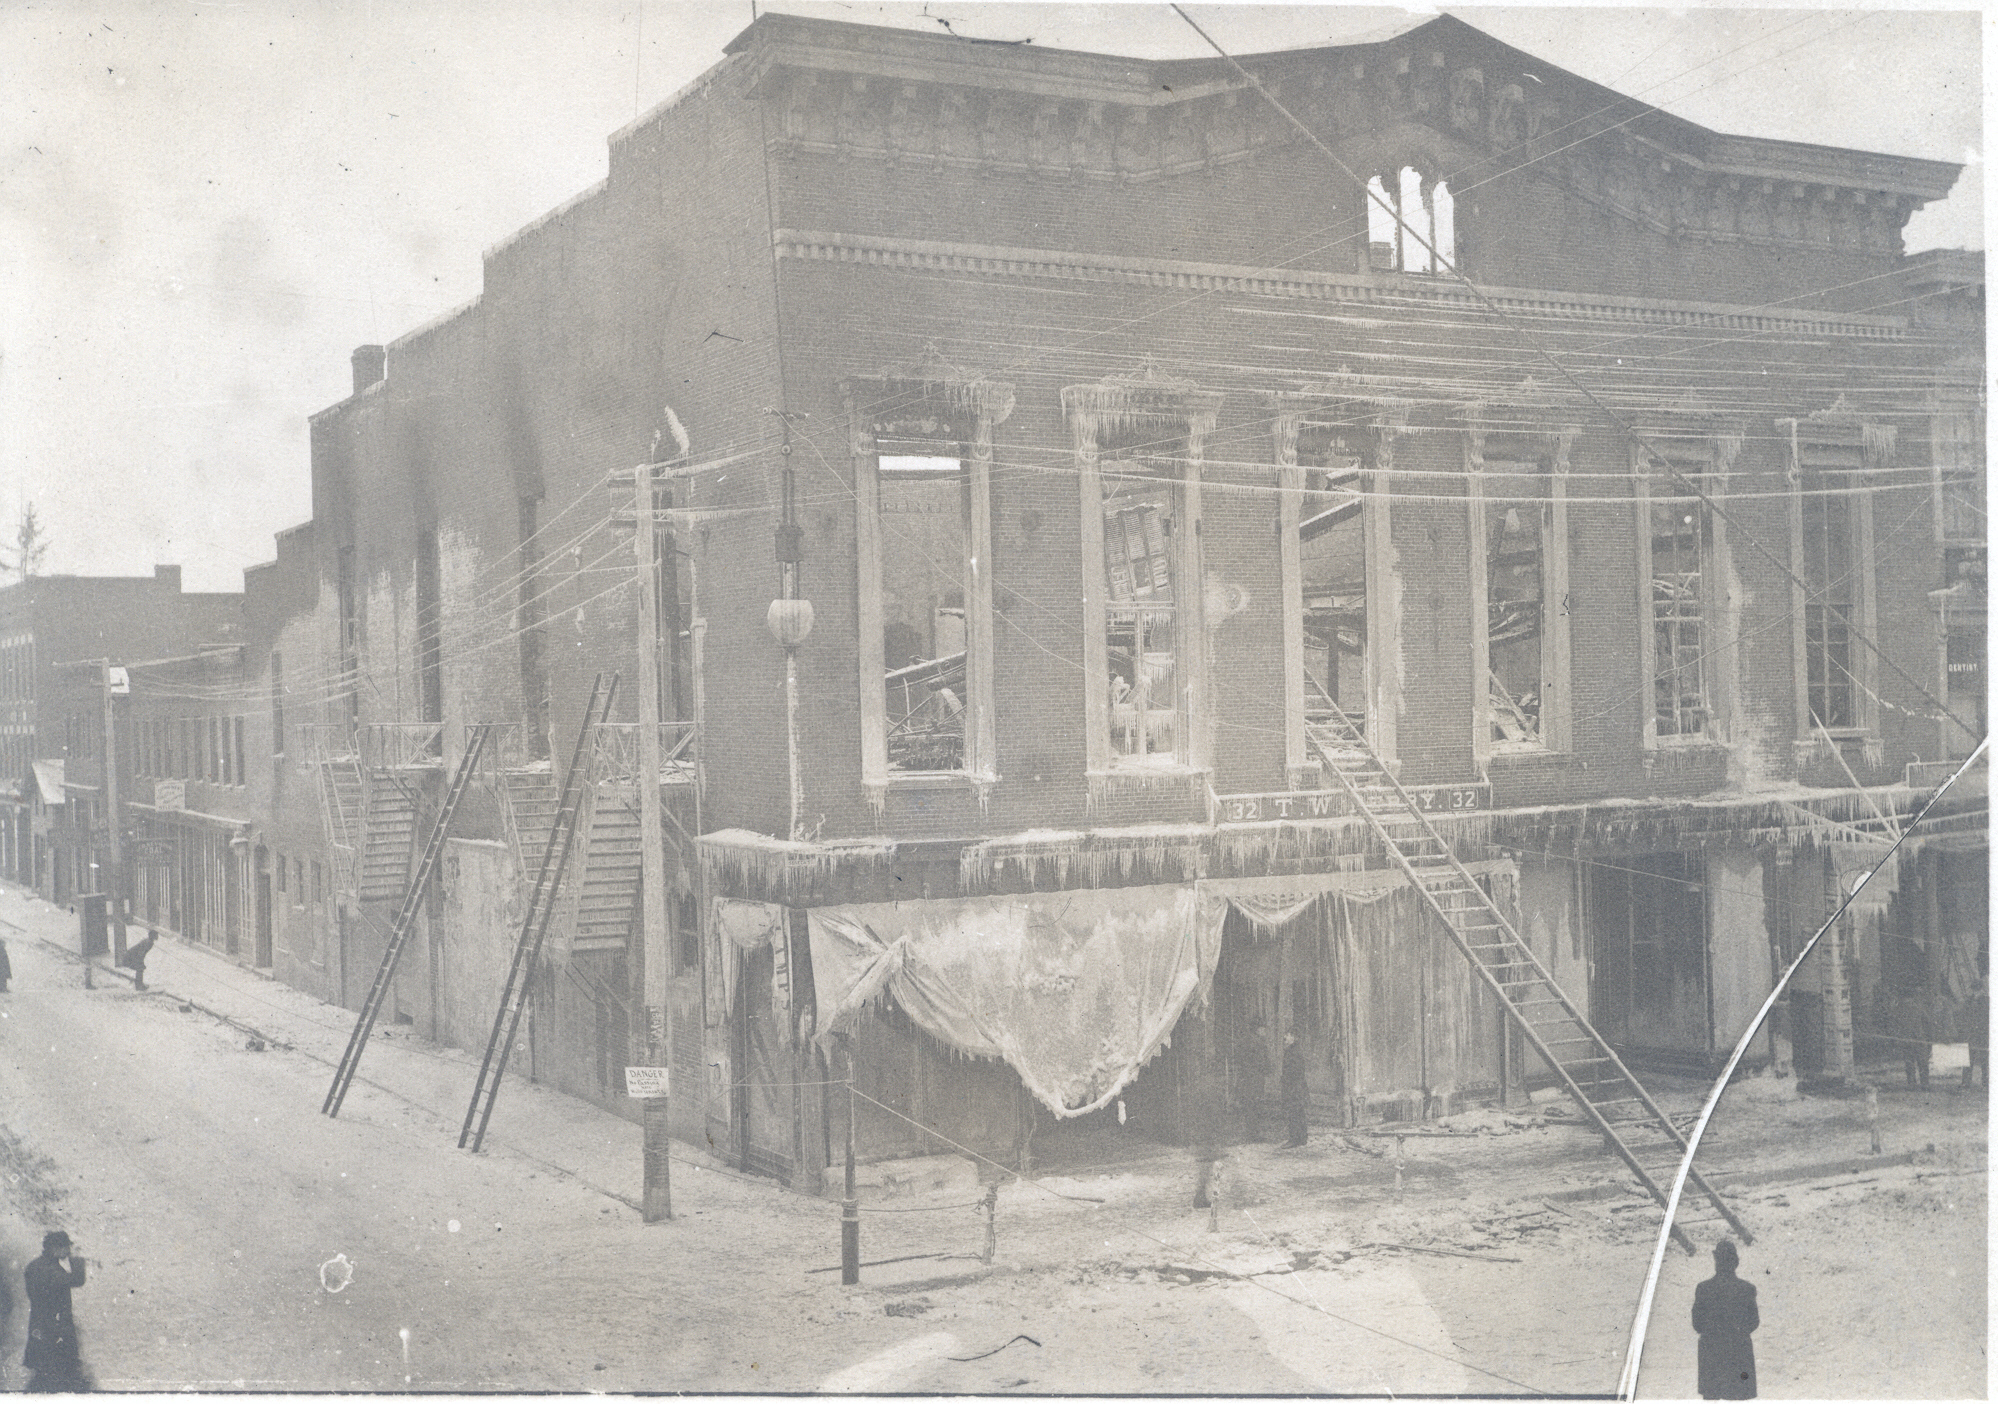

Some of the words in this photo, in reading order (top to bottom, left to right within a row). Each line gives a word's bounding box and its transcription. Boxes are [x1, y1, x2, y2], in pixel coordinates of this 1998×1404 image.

[1232, 802, 1257, 820] 32
[1452, 791, 1475, 808] 32
[629, 1069, 665, 1079] DANGER
